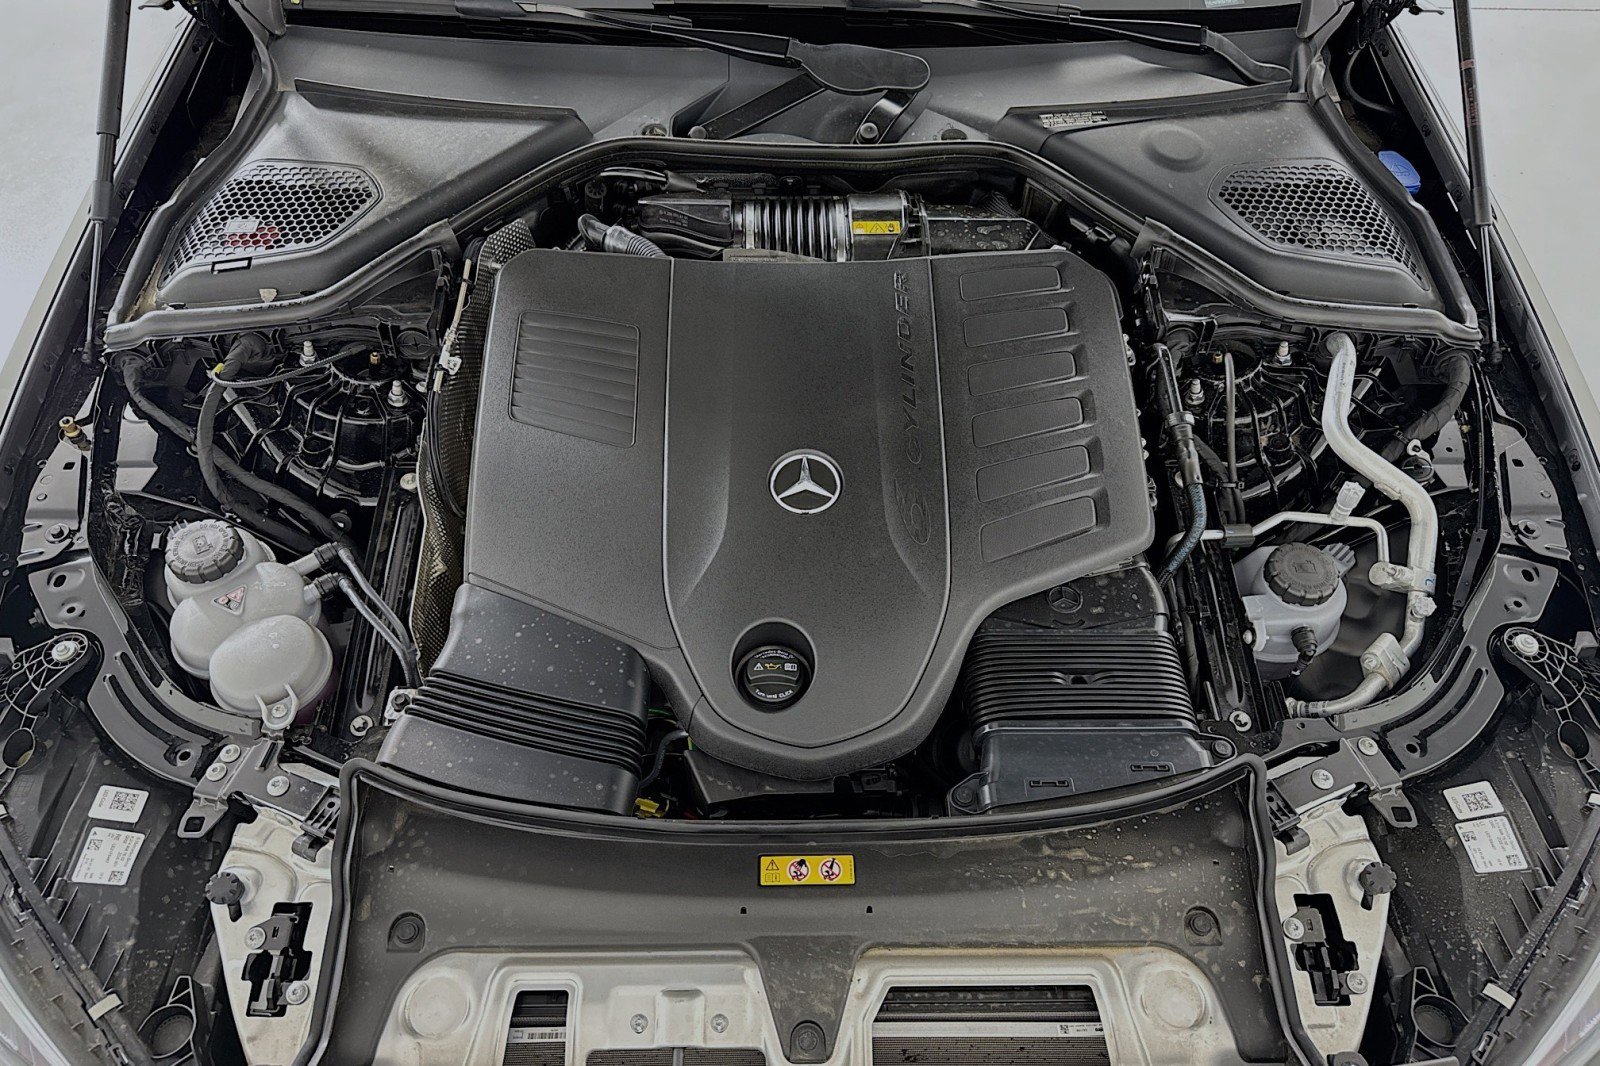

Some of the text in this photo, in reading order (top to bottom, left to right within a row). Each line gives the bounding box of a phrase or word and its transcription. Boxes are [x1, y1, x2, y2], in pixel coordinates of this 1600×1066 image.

[893, 270, 922, 466] CYLINDER
[755, 688, 766, 697] Turn
[778, 689, 794, 698] CLICK
